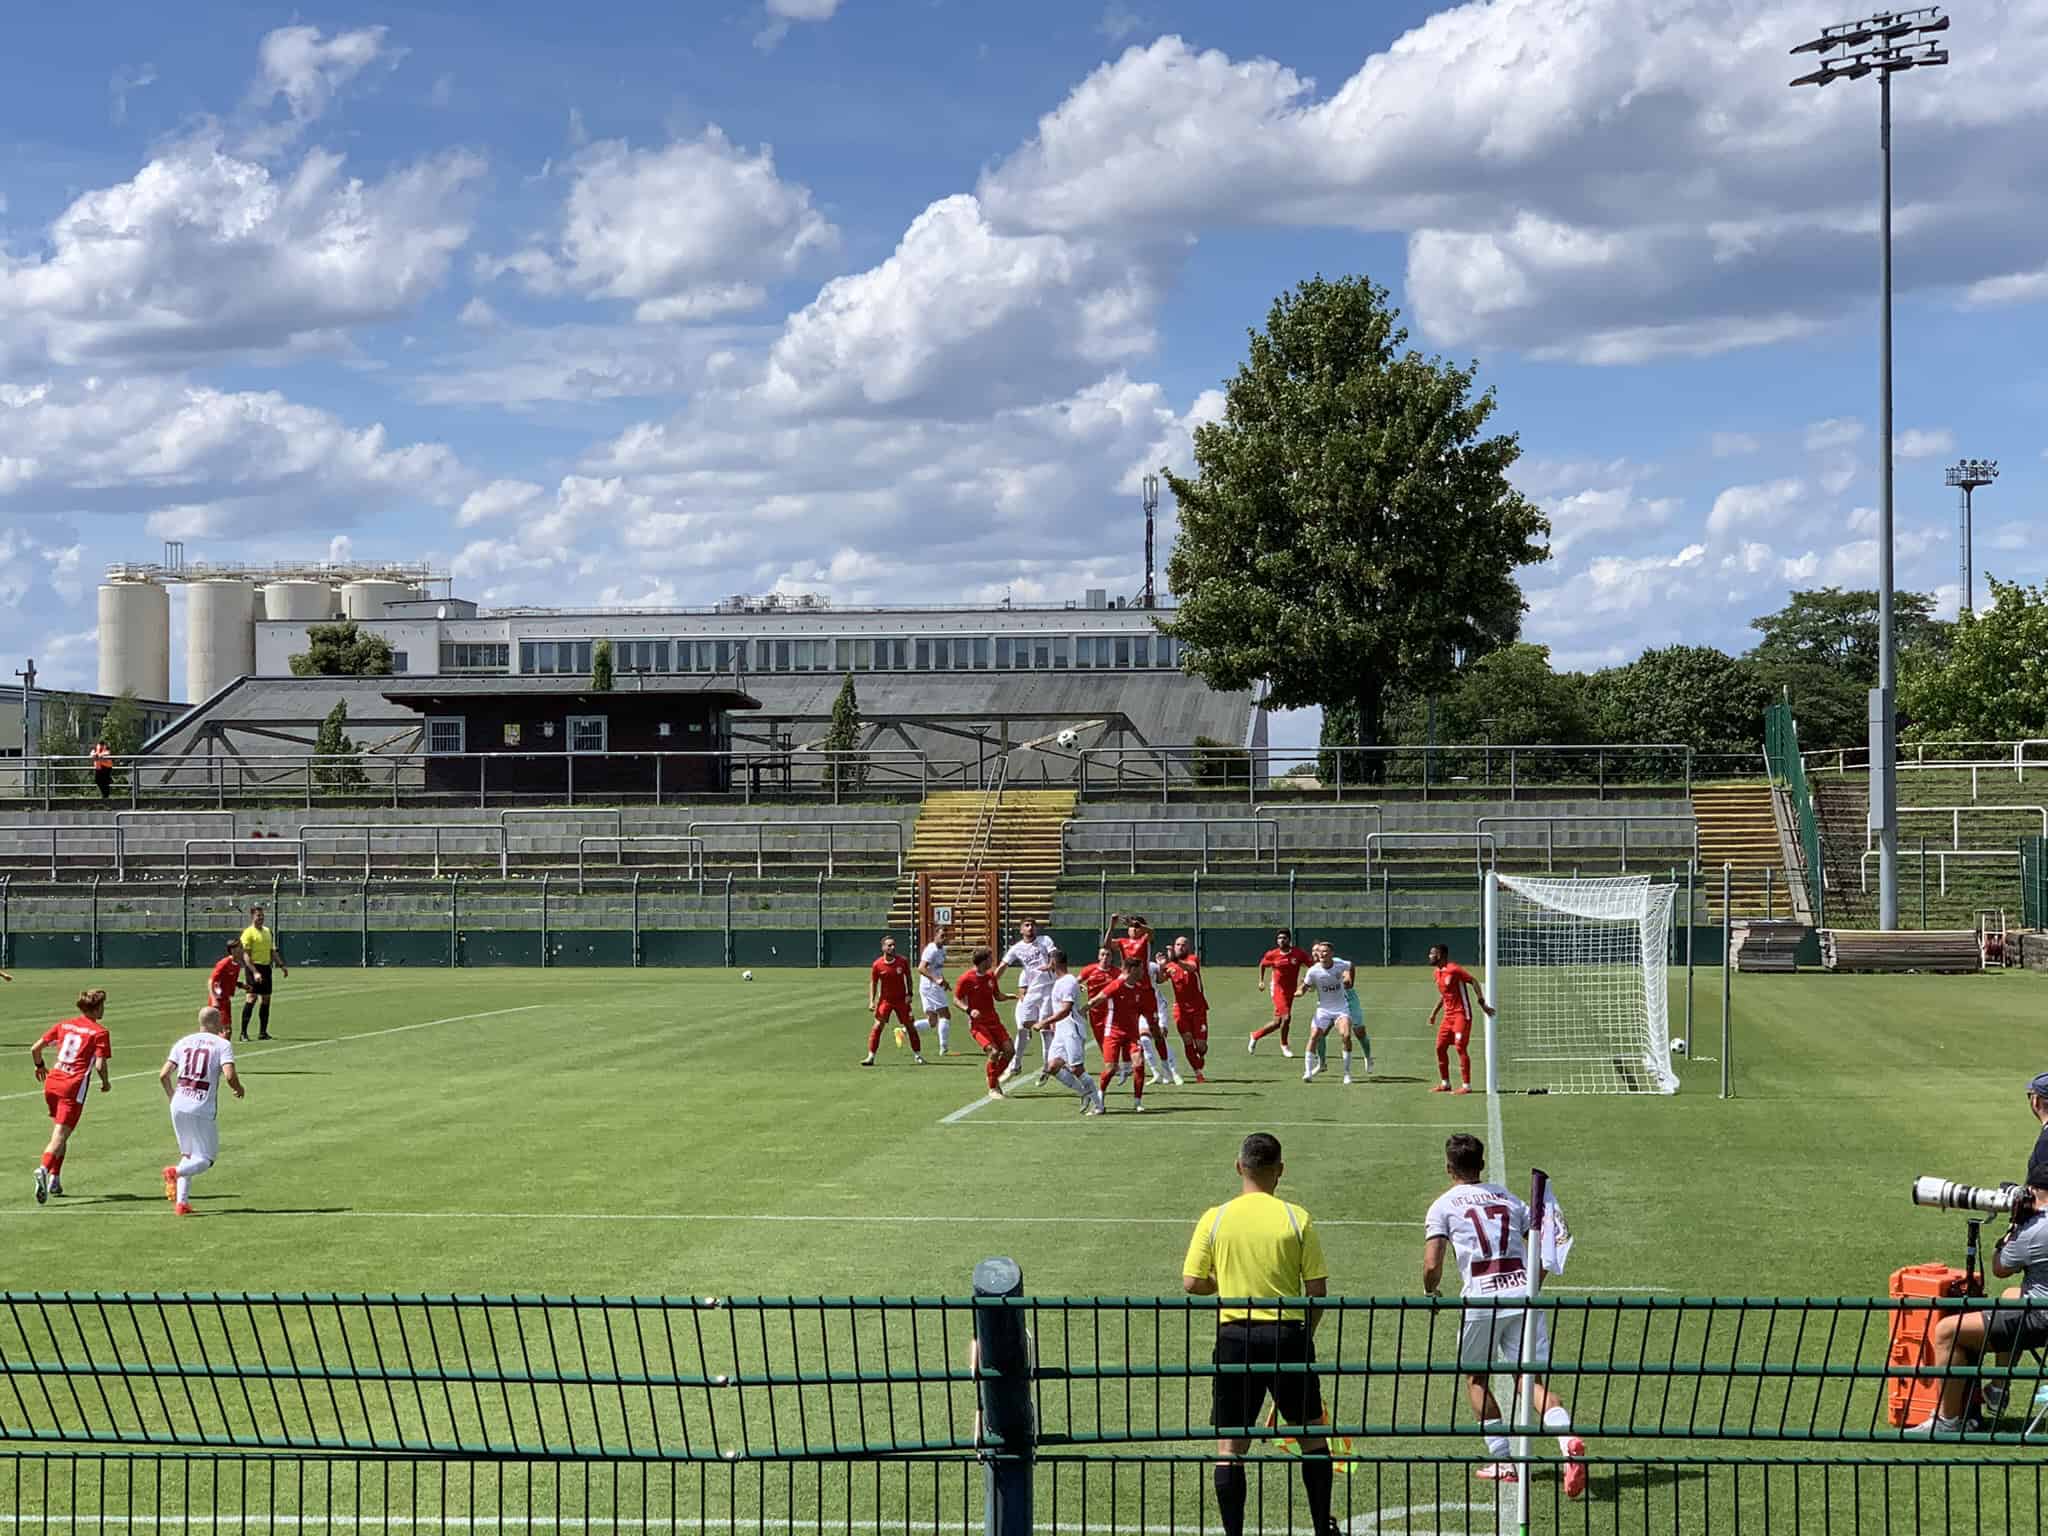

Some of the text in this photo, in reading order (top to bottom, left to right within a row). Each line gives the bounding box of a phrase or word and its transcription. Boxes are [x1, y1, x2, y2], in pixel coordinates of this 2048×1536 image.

[936, 911, 950, 921] 10
[59, 1032, 82, 1063] 8
[184, 1048, 210, 1079] 10
[1464, 1205, 1510, 1258] 17
